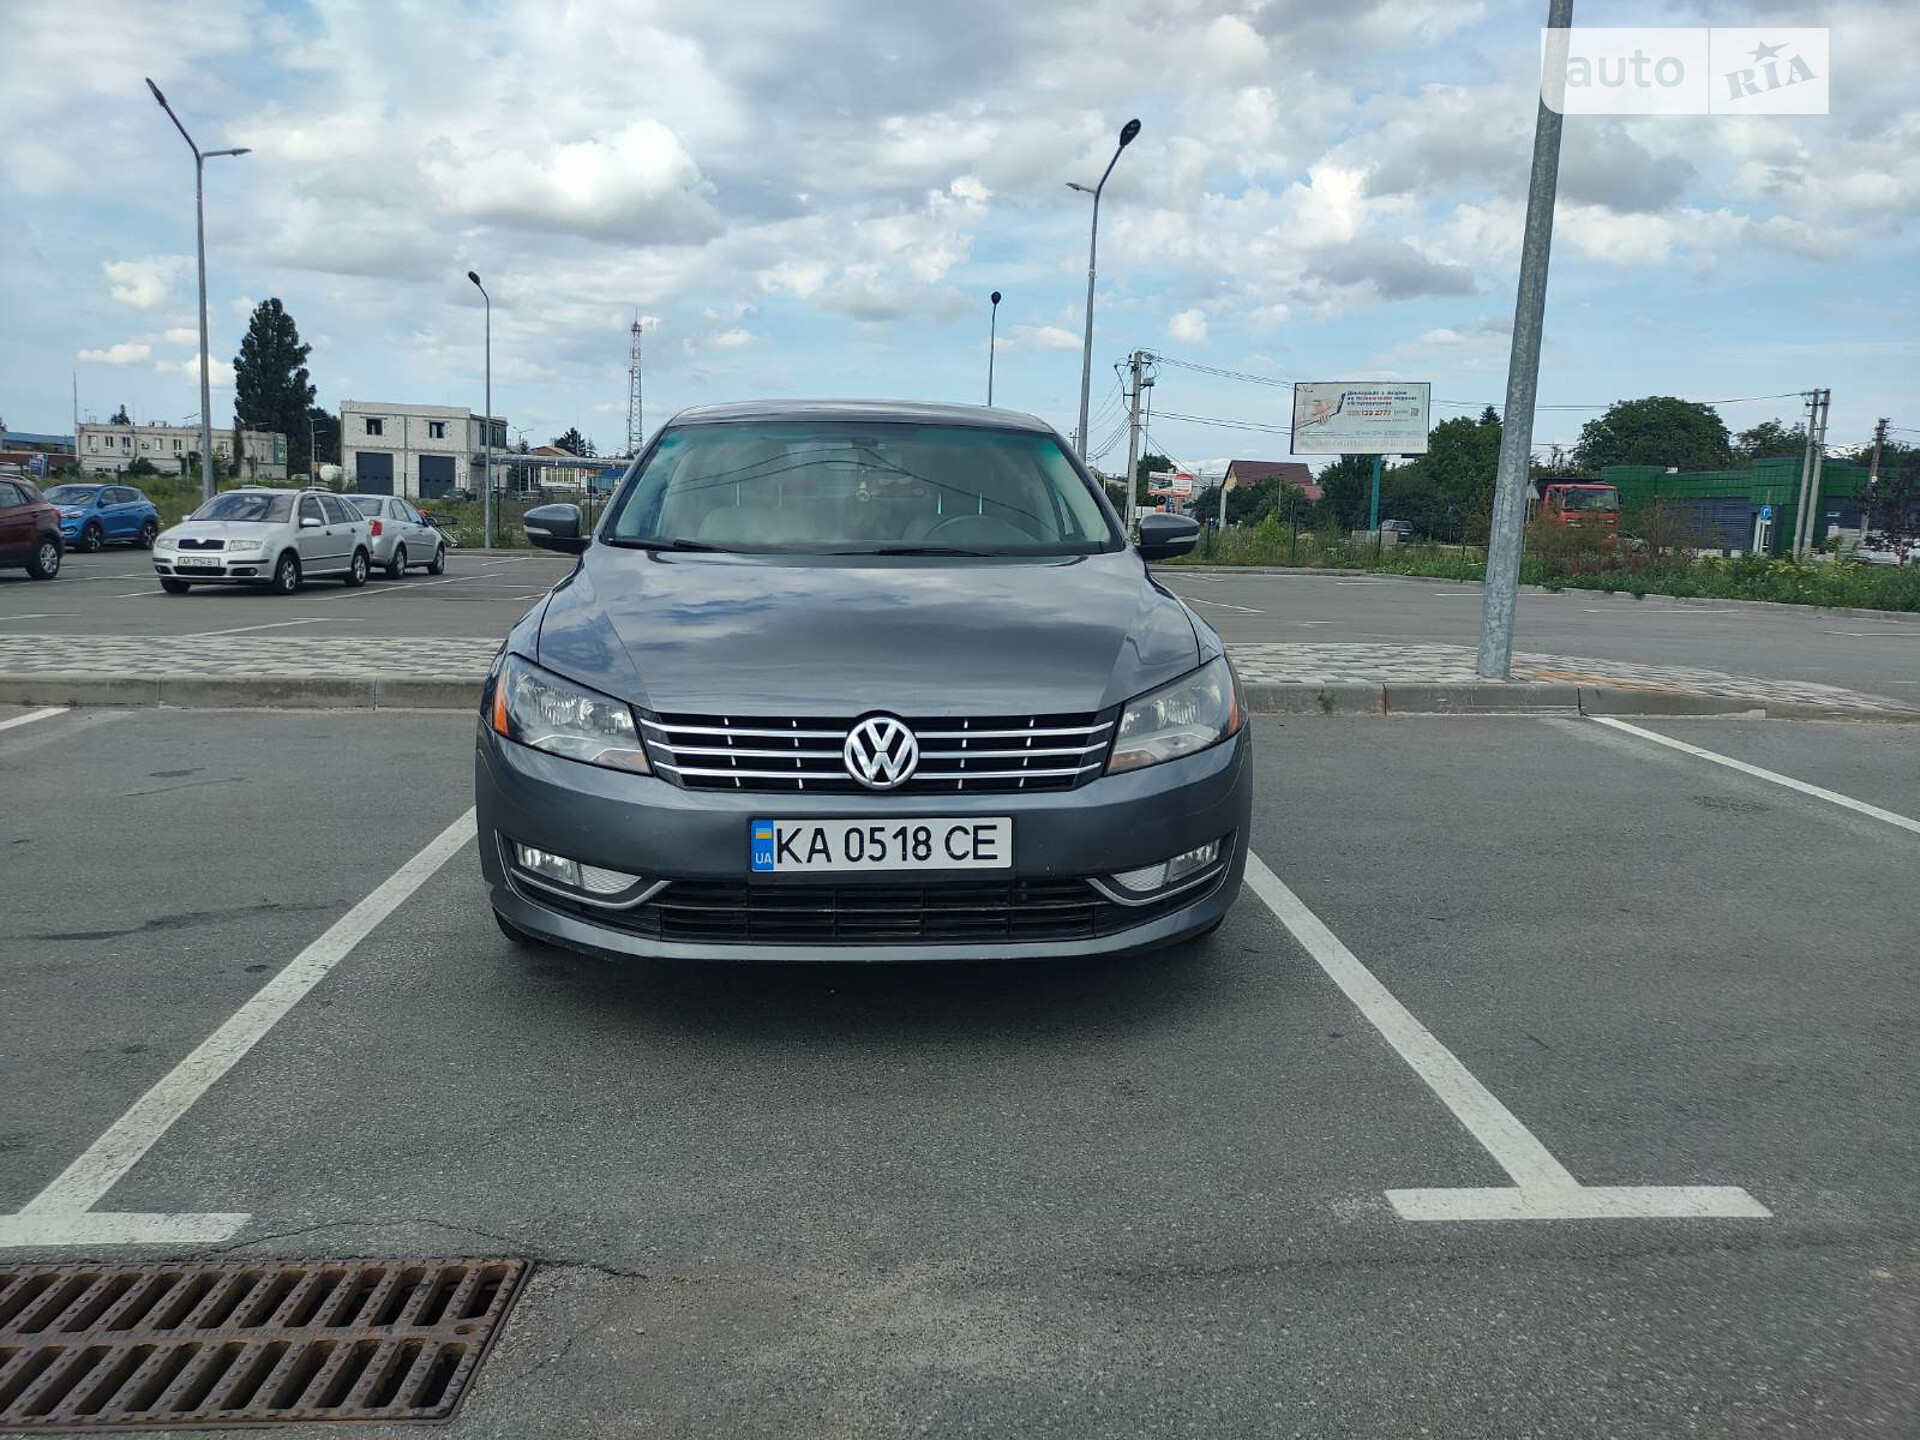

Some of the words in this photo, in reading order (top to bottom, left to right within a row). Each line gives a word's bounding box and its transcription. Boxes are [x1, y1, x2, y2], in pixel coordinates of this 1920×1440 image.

[776, 827, 832, 864] KA
[844, 825, 932, 863] 0518
[944, 824, 998, 861] CE
[755, 852, 773, 865] UA
